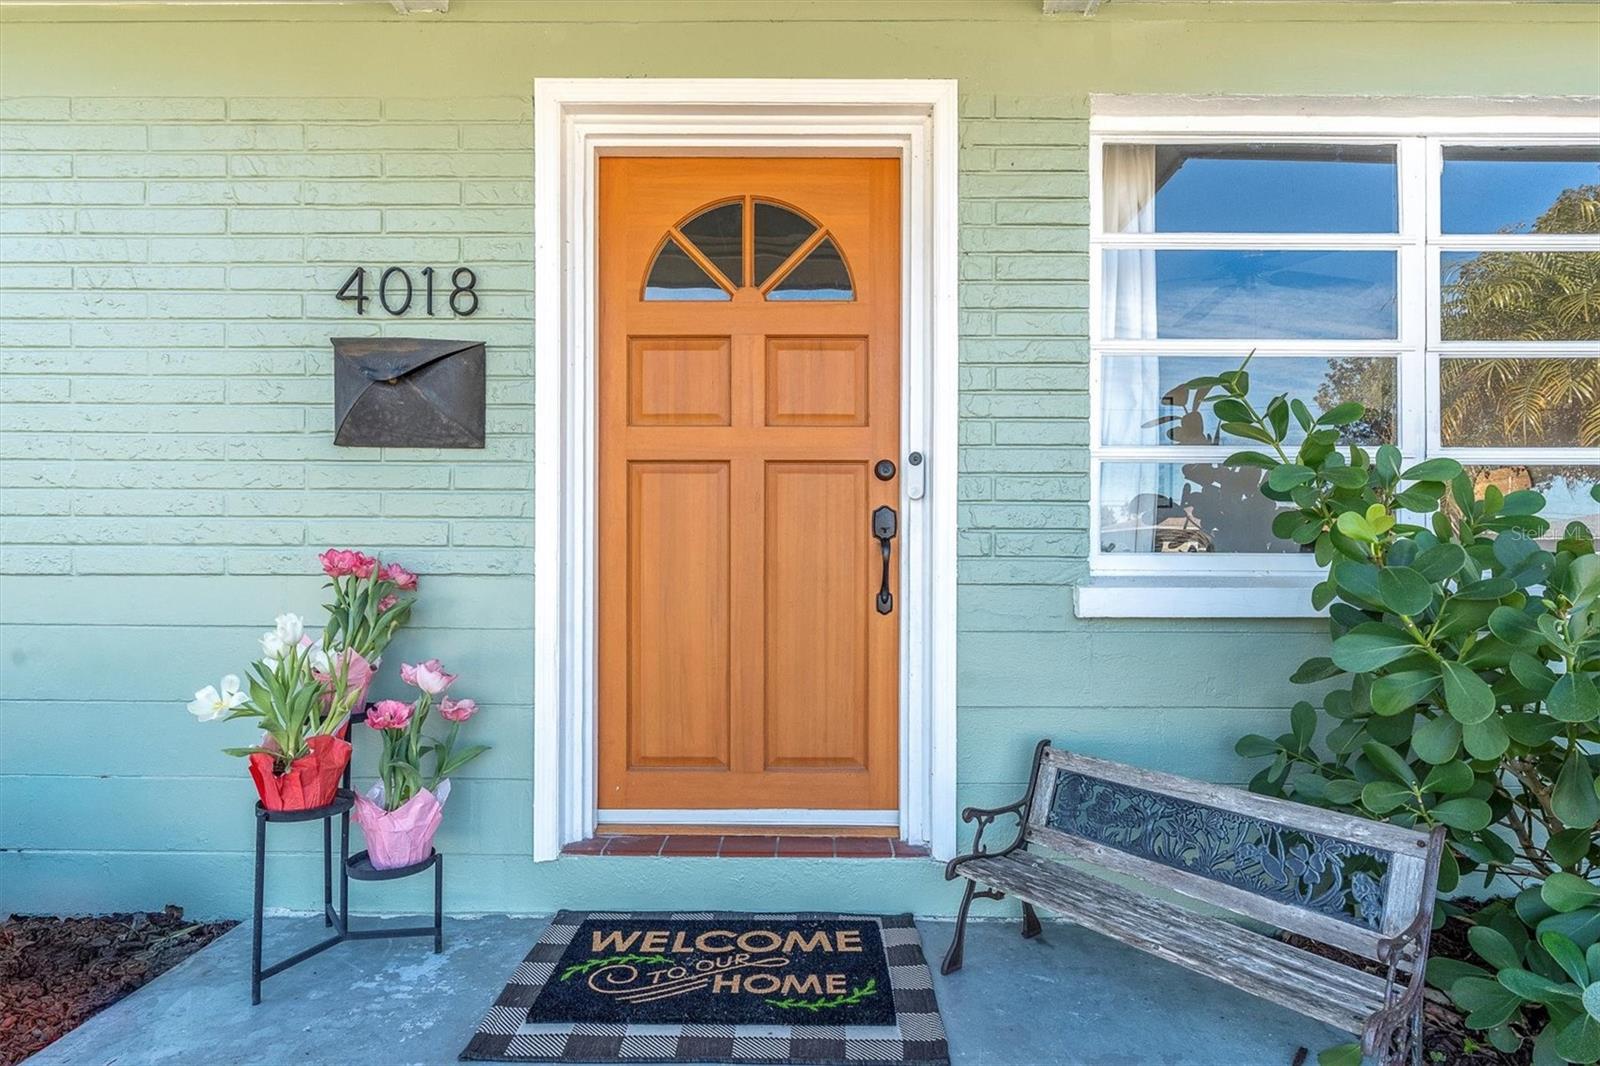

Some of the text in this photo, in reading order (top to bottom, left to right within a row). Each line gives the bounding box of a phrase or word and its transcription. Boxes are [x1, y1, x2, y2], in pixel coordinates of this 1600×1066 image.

[335, 266, 479, 316] 4018
[592, 930, 862, 953] WELCOME
[646, 953, 750, 984] TO OUR
[712, 973, 847, 994] HOME
